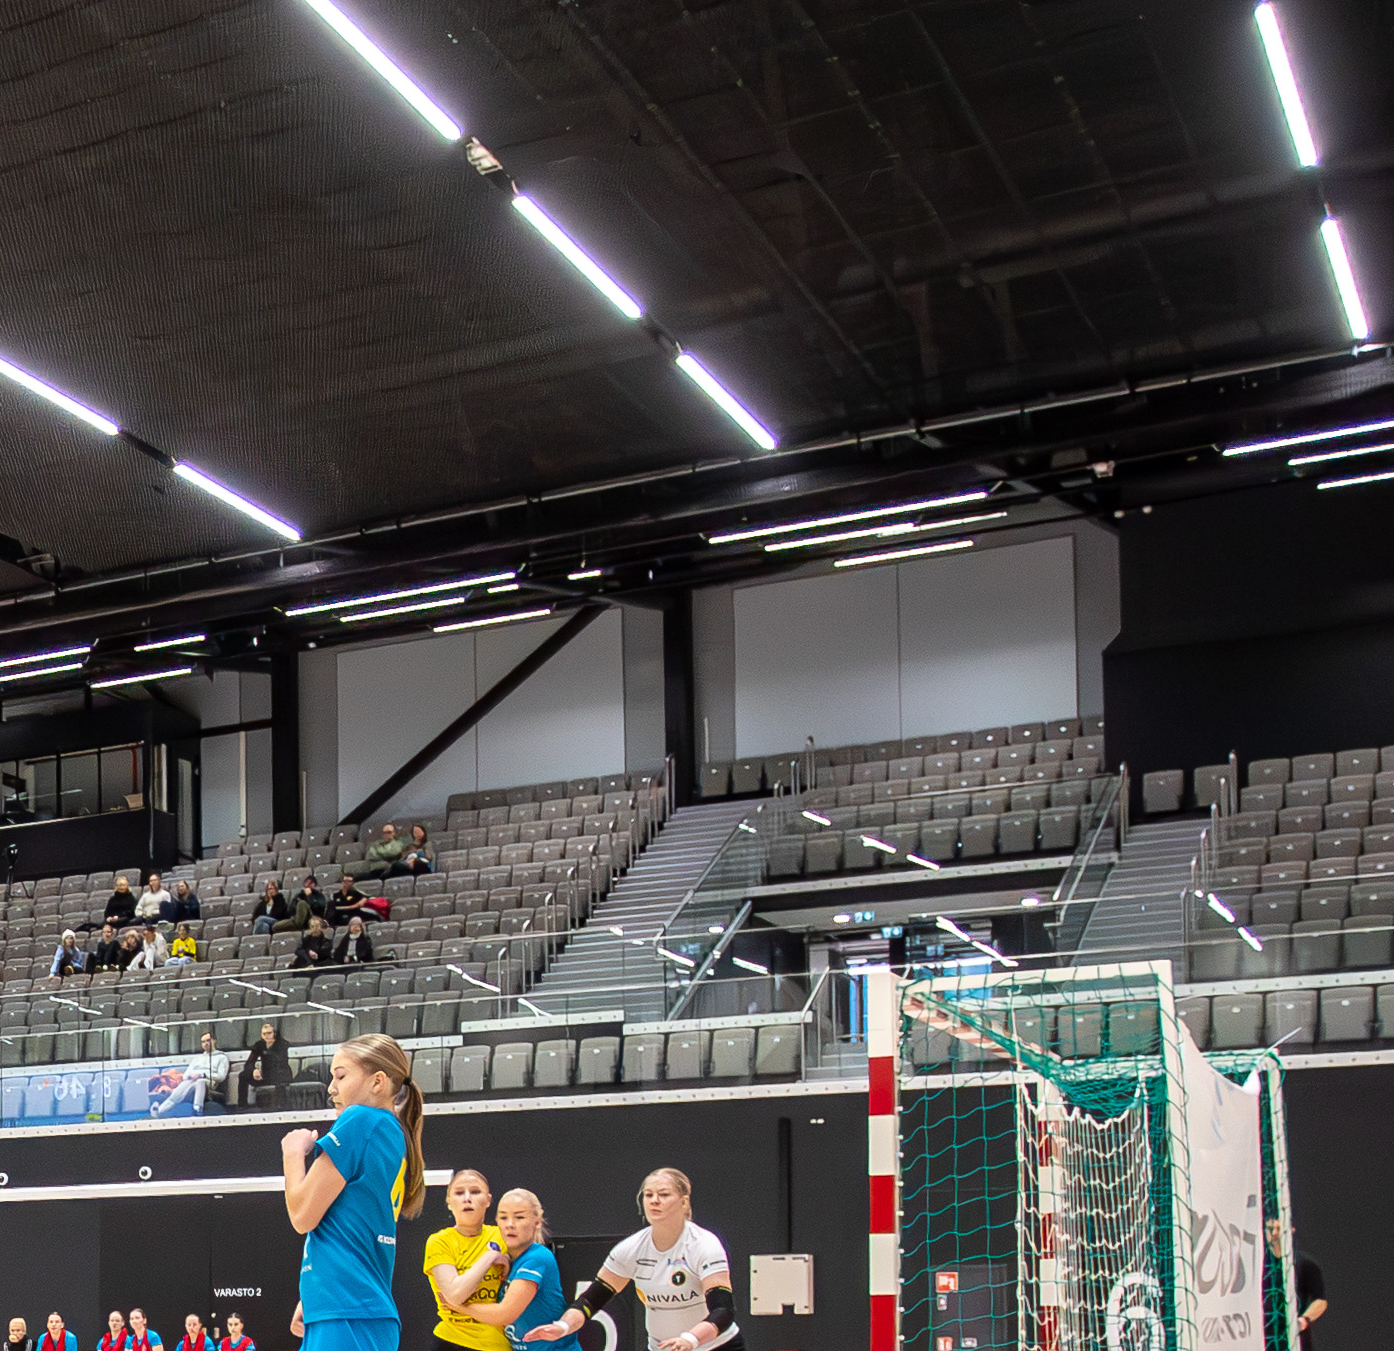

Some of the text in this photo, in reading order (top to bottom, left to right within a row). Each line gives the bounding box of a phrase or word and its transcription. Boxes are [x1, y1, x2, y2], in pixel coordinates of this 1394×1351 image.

[213, 1287, 262, 1298] VARASTO 2
[646, 1290, 700, 1303] NIVALA
